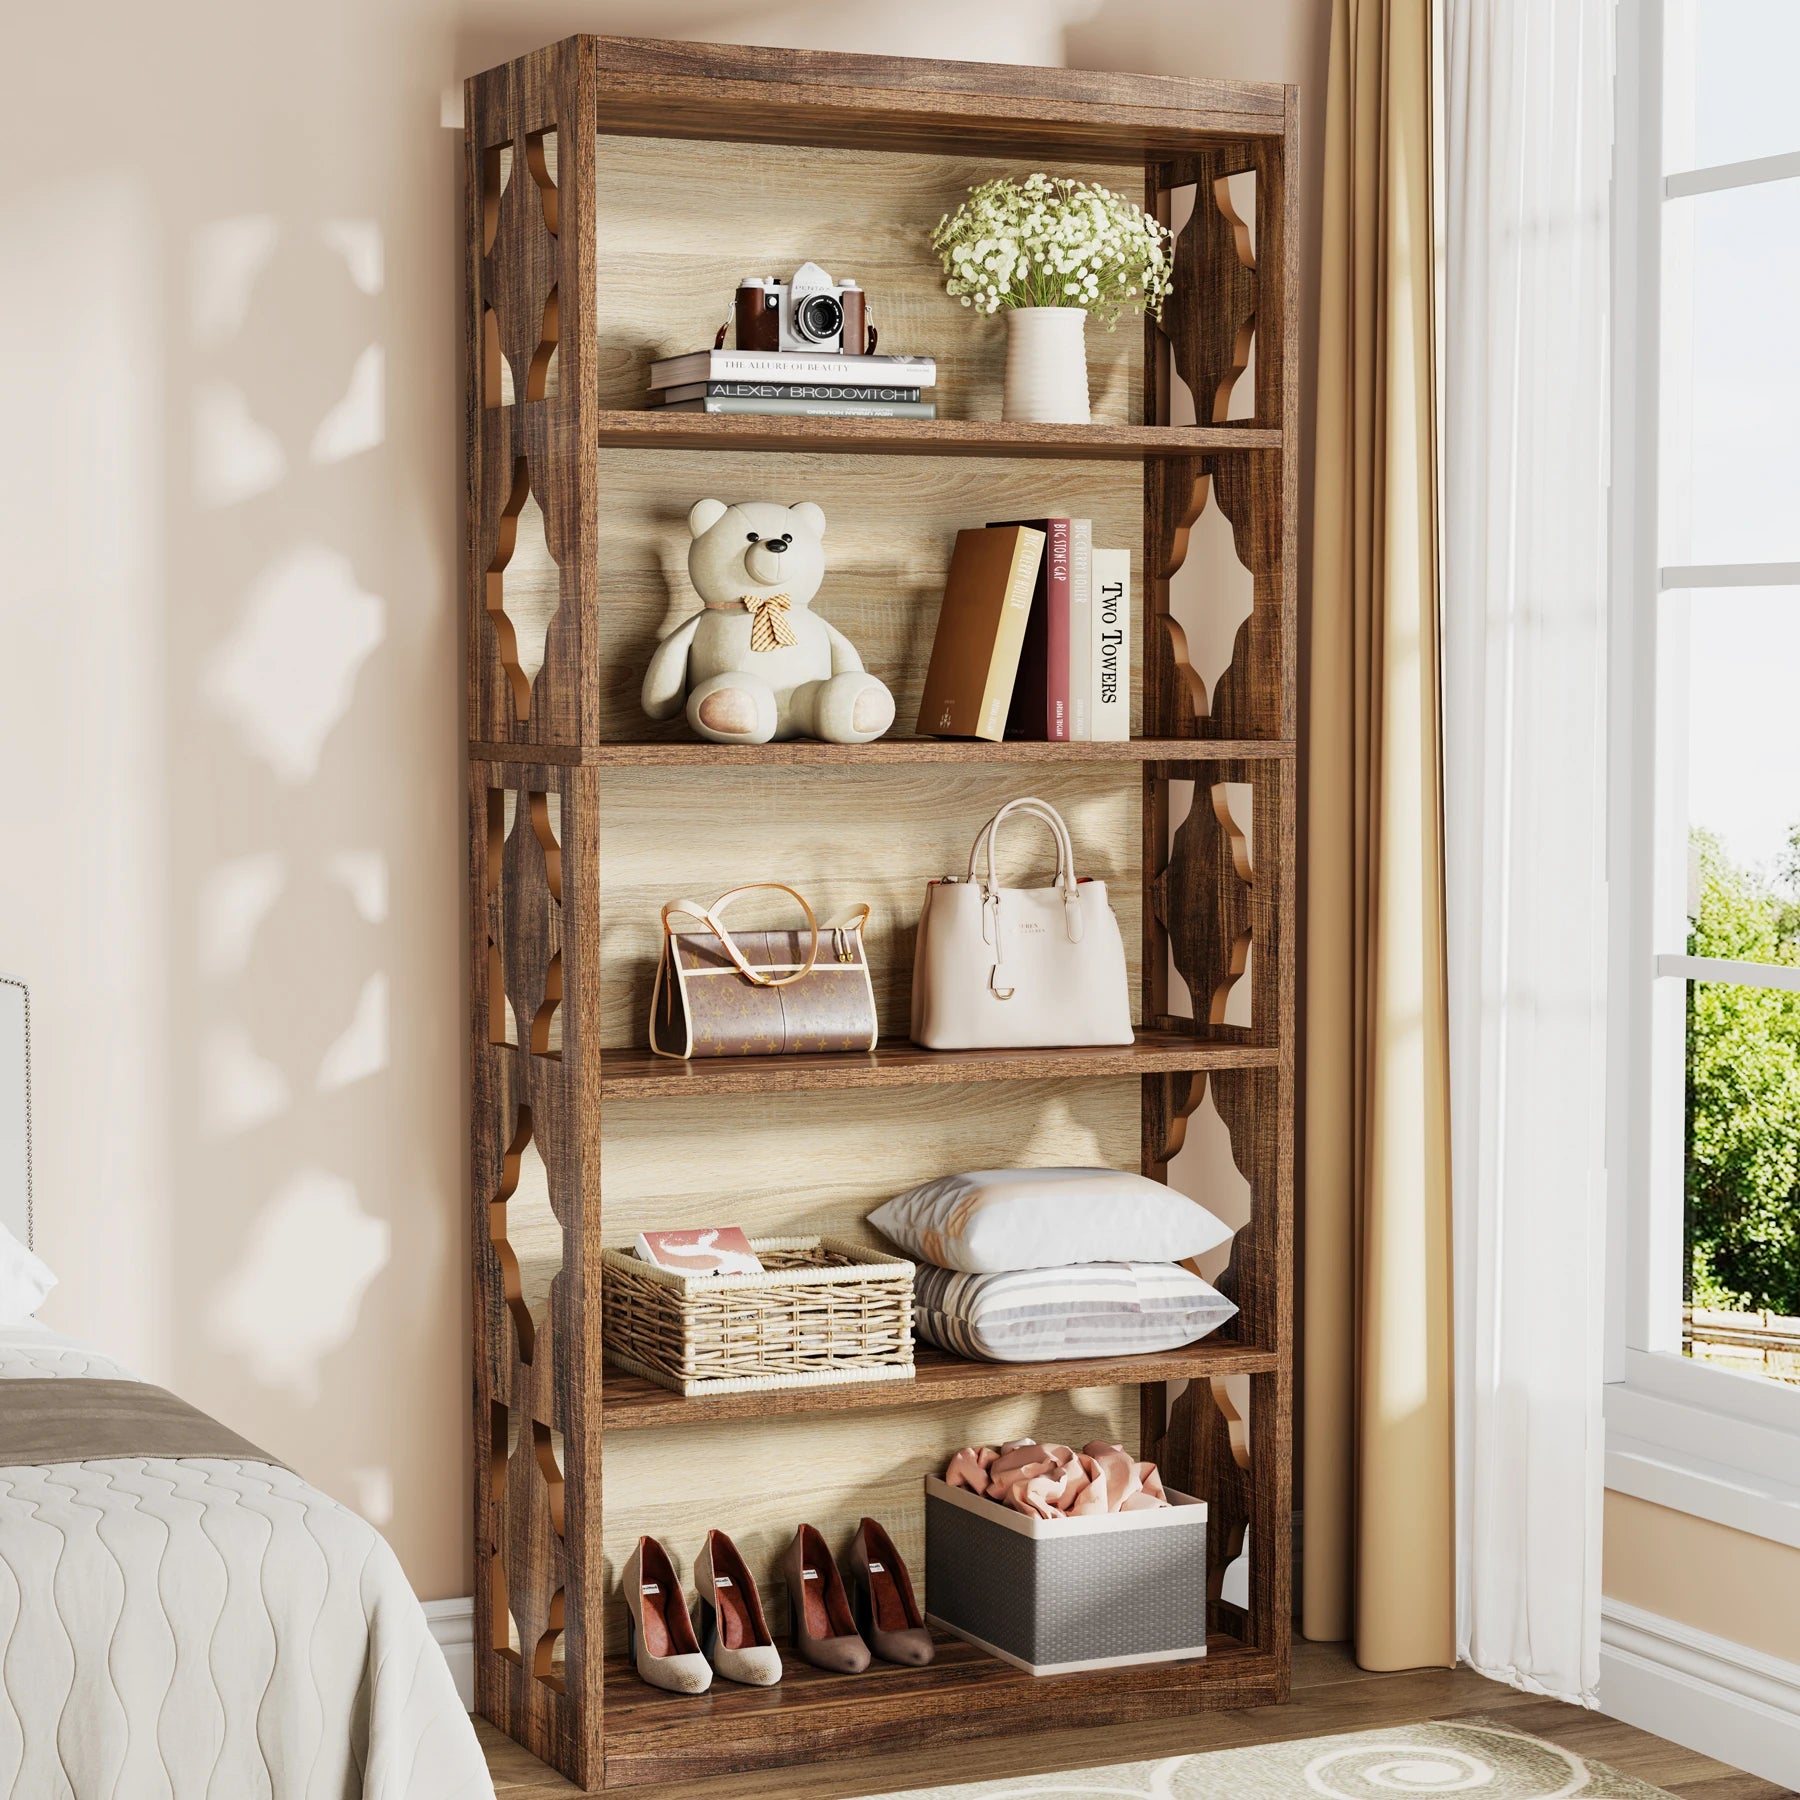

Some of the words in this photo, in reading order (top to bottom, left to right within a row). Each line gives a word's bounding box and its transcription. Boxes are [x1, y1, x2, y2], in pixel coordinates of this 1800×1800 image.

[725, 361, 745, 369] THE
[808, 364, 848, 372] BEAUTY
[712, 384, 784, 397] ALEXEY
[790, 386, 907, 400] BRODOVITCH
[1053, 524, 1067, 538] BIG
[1075, 525, 1088, 539] BIG
[1024, 533, 1040, 548] BIG
[1053, 540, 1067, 563] STONE
[1017, 549, 1036, 578] CHERRY
[1053, 566, 1067, 581] GAP
[1009, 579, 1029, 608] HOLLER
[1102, 582, 1122, 624] TWO
[1102, 629, 1122, 703] TOWERS
